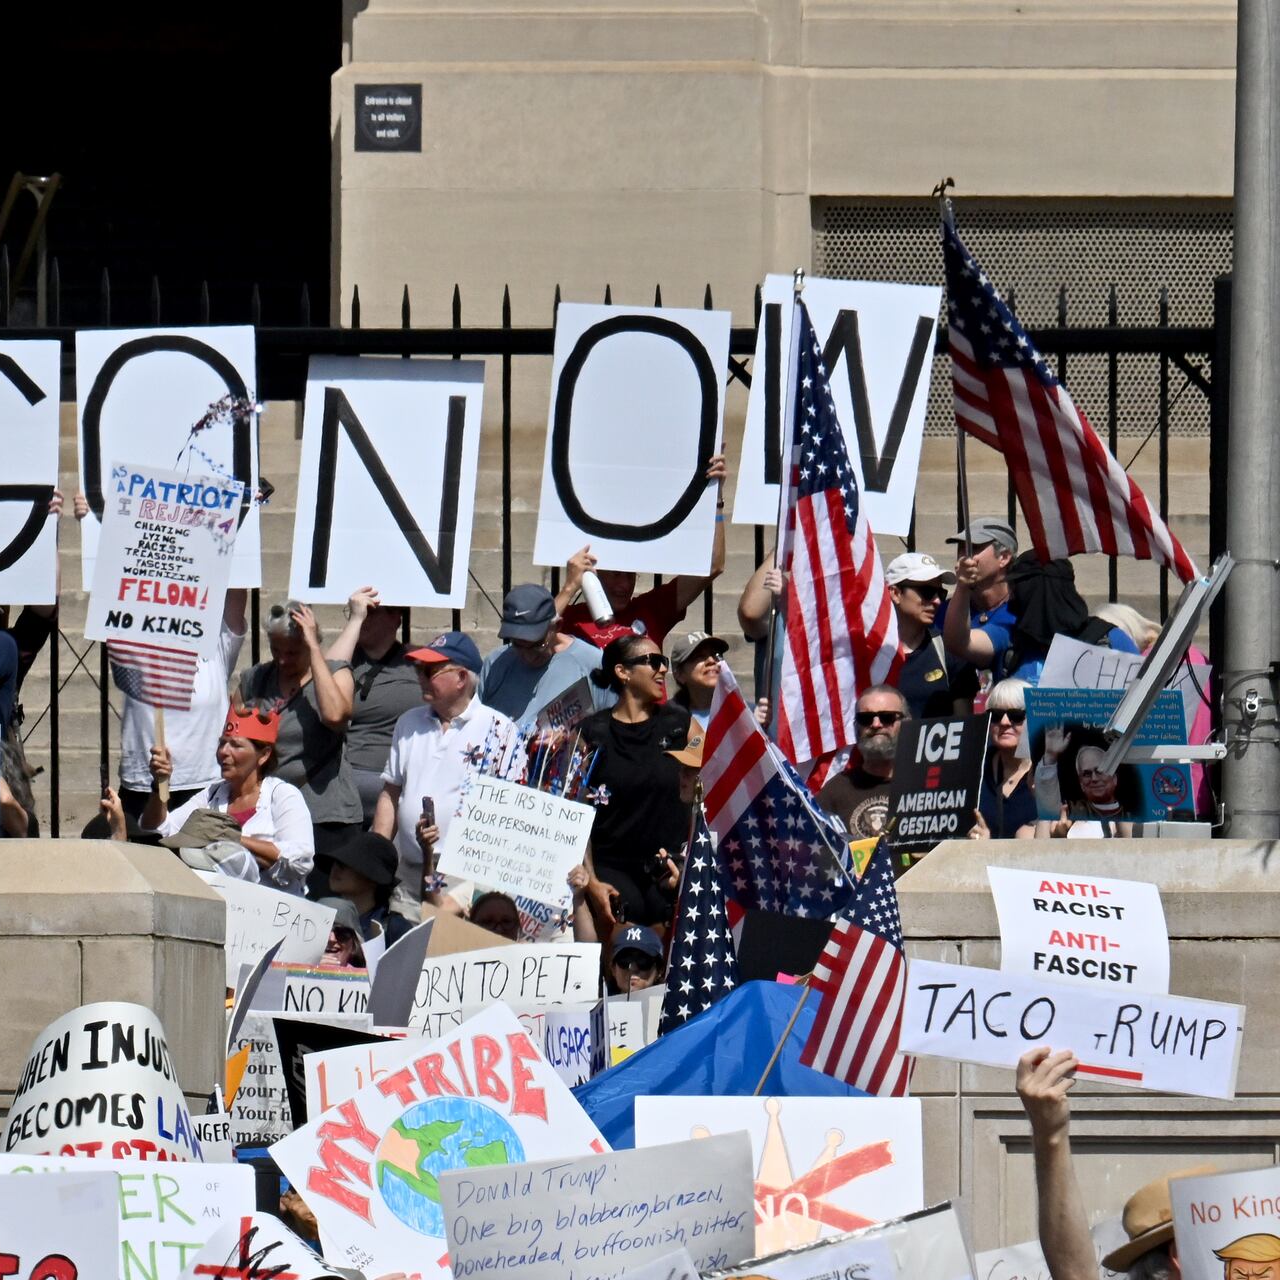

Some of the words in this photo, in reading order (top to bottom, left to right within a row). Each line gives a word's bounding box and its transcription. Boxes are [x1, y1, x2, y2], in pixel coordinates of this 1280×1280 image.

[129, 473, 239, 510] PATRIOT
[134, 521, 190, 537] CHEATING
[142, 533, 176, 544] LYING
[124, 547, 194, 564] TREASONOUS
[138, 540, 184, 554] RACIST
[136, 558, 183, 572] FASCIST
[118, 578, 209, 610] FELON!
[105, 610, 134, 629] NO
[141, 615, 204, 638] KINGS
[915, 721, 965, 765] ICE
[476, 783, 509, 805] THE
[514, 791, 535, 810] IRS
[542, 798, 553, 817] IS
[559, 807, 586, 825] NOT
[896, 789, 966, 814] AMERICAN
[466, 804, 497, 826] YOUR
[498, 816, 551, 840] PERSONAL
[554, 831, 579, 846] BANK
[898, 813, 958, 837] GESTAPO
[457, 844, 494, 863] ARMED
[494, 856, 531, 875] FORCES
[537, 868, 555, 880] ARE
[541, 850, 558, 863] THE
[463, 861, 490, 876] NOT
[497, 870, 524, 884] YOUR
[527, 879, 553, 894] TOYS
[1038, 880, 1112, 898] ANTI-
[1033, 899, 1125, 921] RACIST
[1048, 929, 1121, 953] ANTI-
[1034, 952, 1137, 984] FASCIST
[919, 983, 1056, 1041] TACO
[376, 1030, 550, 1124] TRIBE
[5, 1092, 146, 1152] BECOMES
[307, 1098, 381, 1229] MY
[457, 1173, 533, 1208] Donald
[542, 1163, 619, 1192] Trump:
